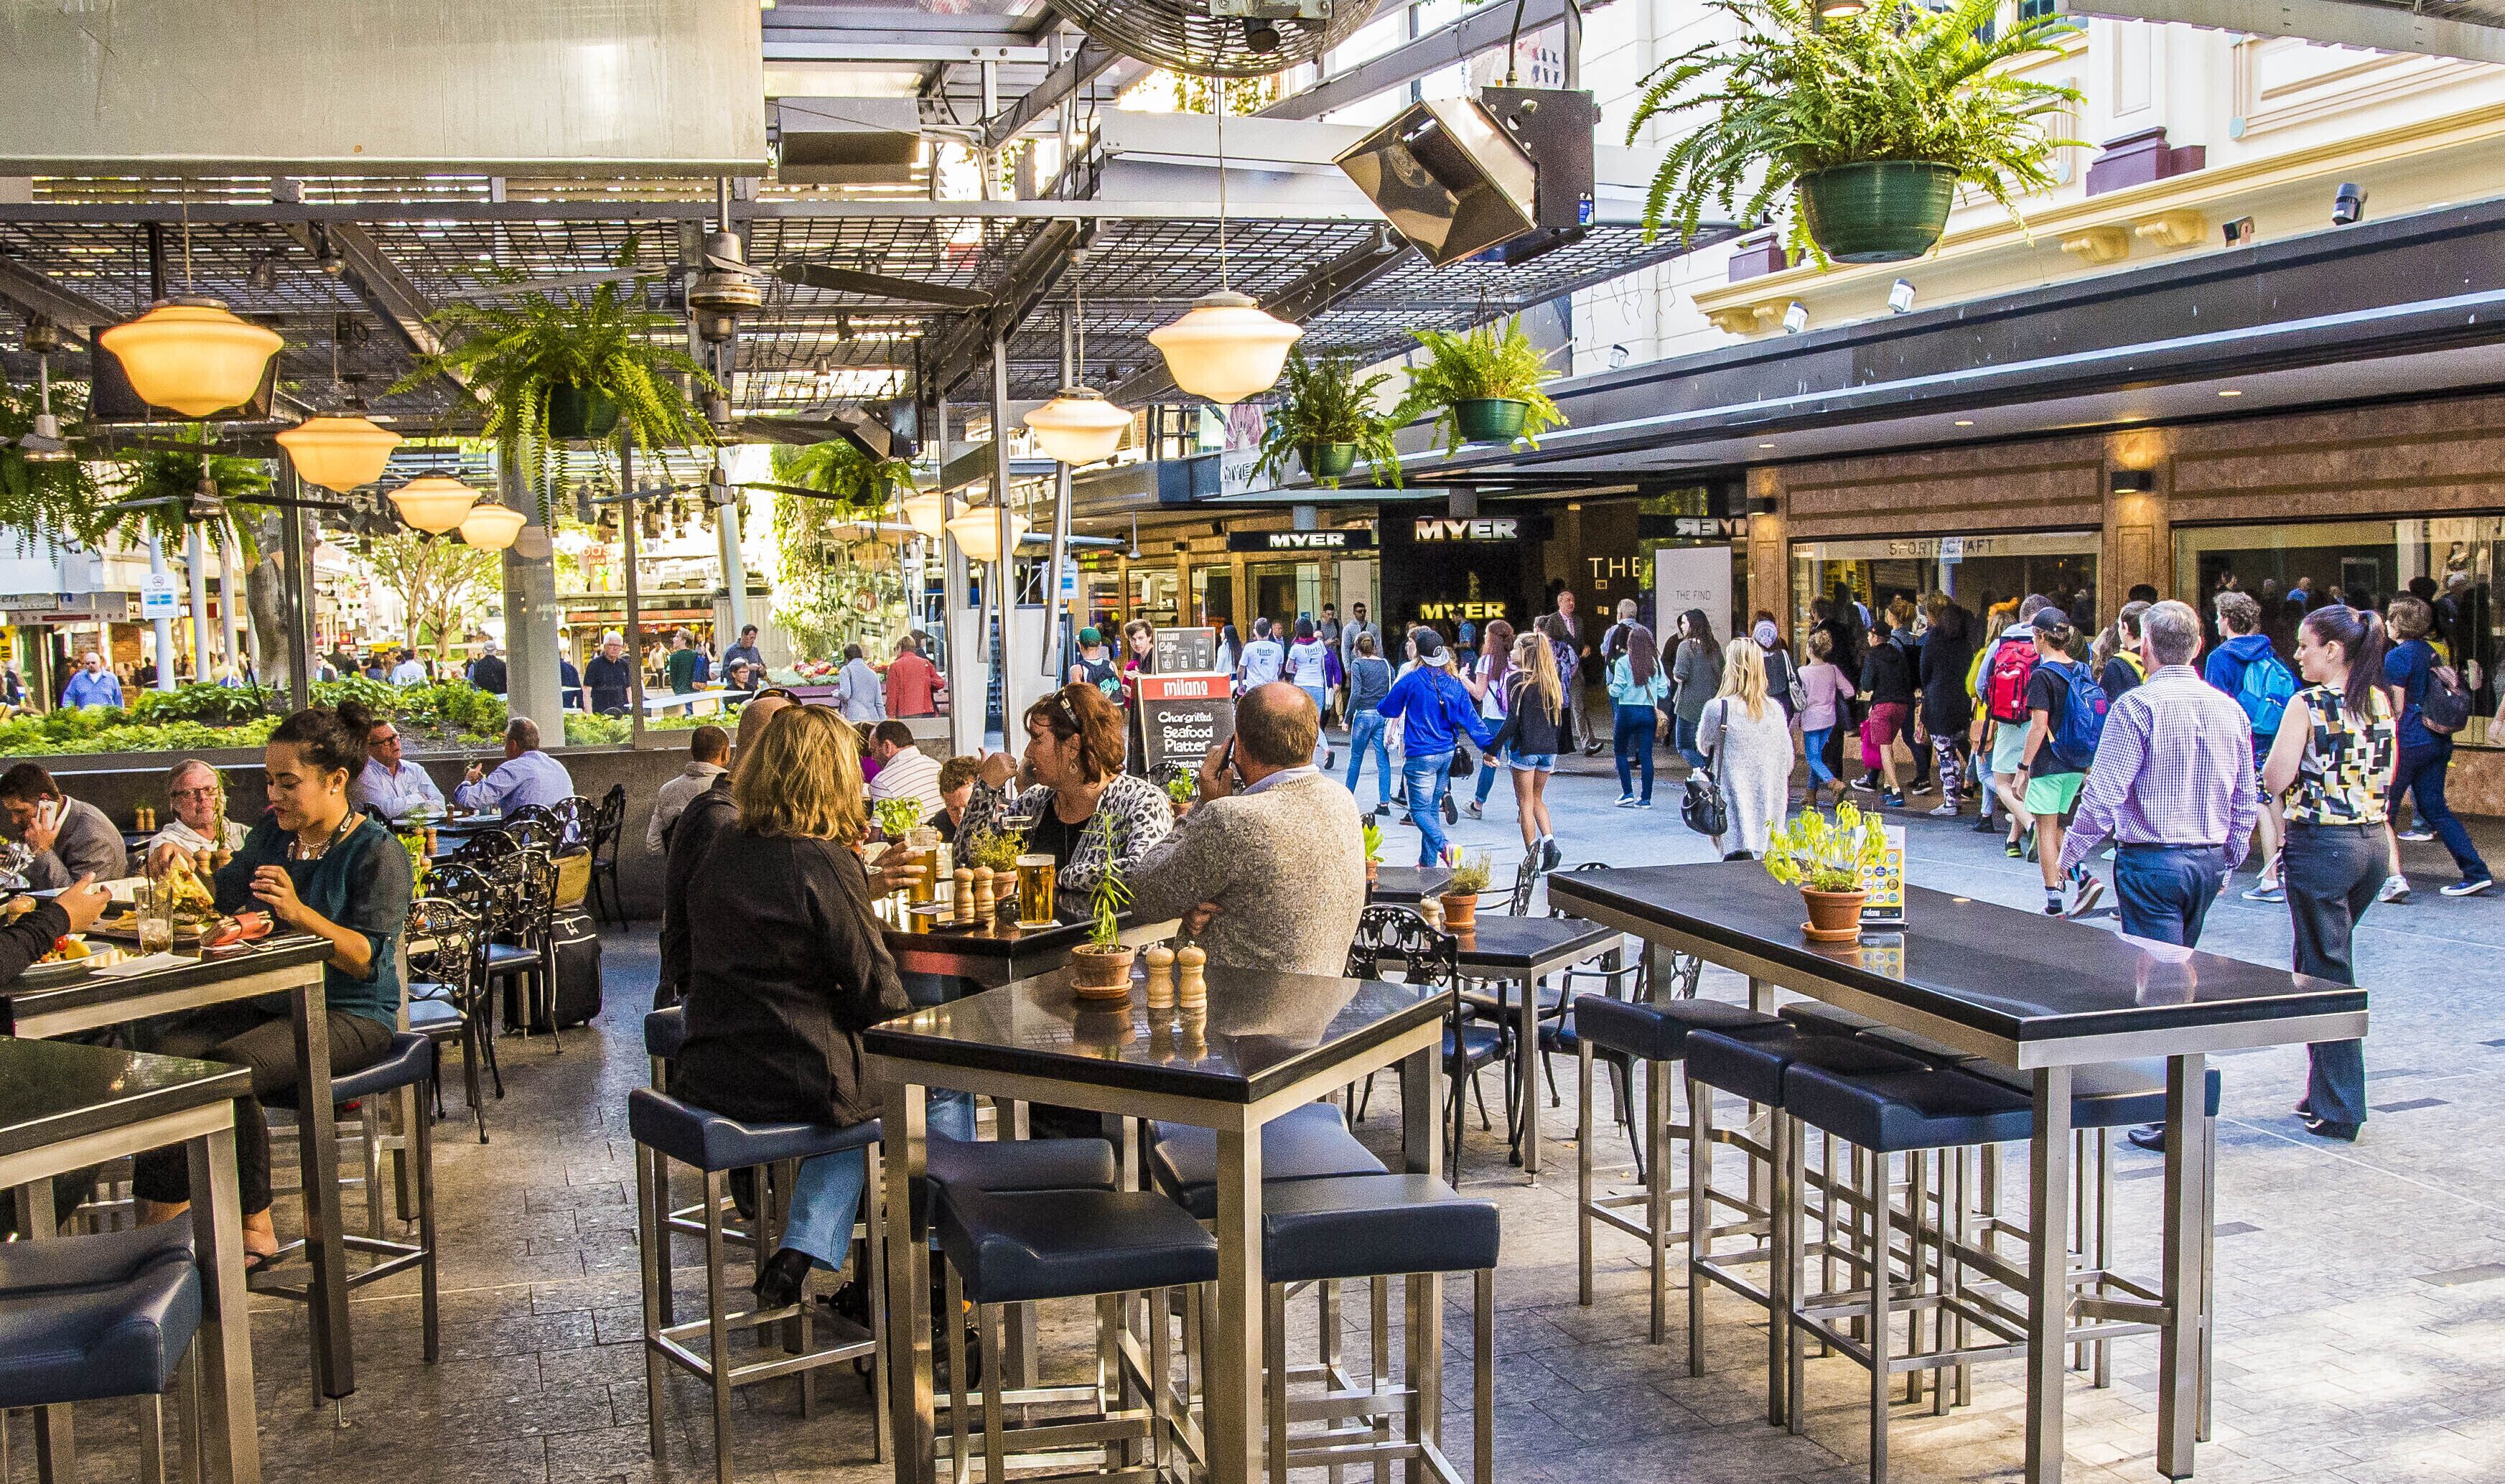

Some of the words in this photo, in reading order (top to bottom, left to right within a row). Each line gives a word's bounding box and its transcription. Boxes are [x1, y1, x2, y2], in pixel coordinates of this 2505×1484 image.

[1415, 519, 1518, 541] MYER
[1269, 533, 1345, 548] MYER
[1888, 538, 1994, 556] SORTSCRAFT
[1676, 590, 1690, 600] THE
[1693, 590, 1711, 600] FIND
[1163, 678, 1208, 697] milano
[1163, 724, 1213, 739] Seafood
[1164, 739, 1211, 752] Platter
